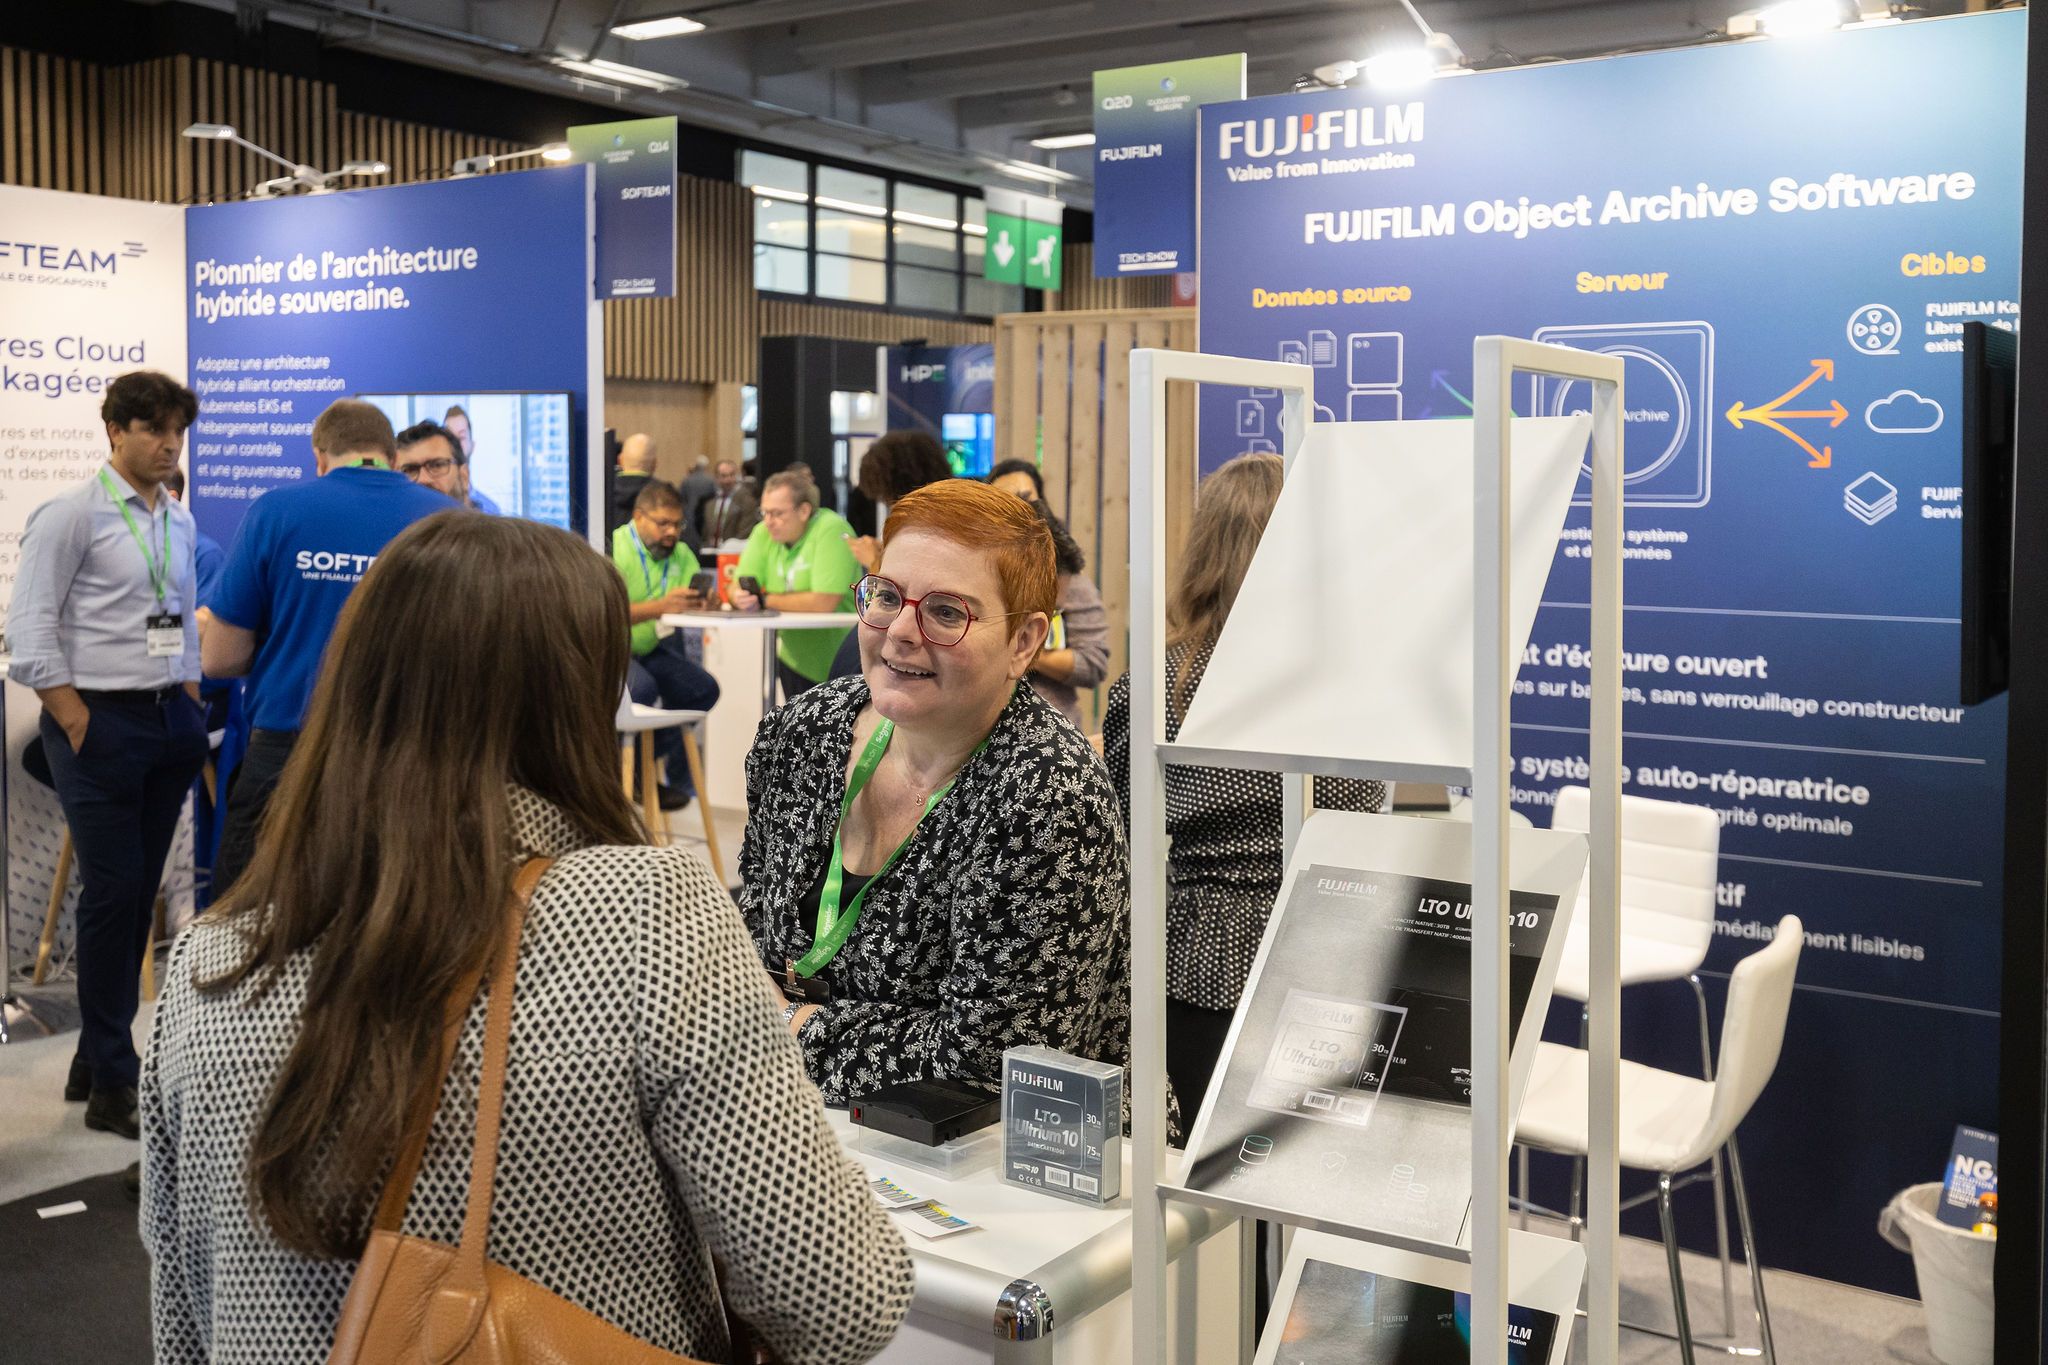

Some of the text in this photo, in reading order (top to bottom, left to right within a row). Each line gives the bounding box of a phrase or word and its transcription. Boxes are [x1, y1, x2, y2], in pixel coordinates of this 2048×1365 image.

[1219, 102, 1425, 160] FUJIFILM
[1100, 144, 1162, 162] FUJIFILM
[1227, 151, 1415, 182] Value from Innovation
[621, 185, 671, 200] SOFTEAM
[1304, 171, 1976, 244] FUJIFILM Object Archive Software
[195, 246, 479, 286] Pionnier de l'architecture
[1901, 250, 1987, 278] Cibles
[1575, 271, 1669, 294] Serveur
[195, 281, 410, 324] hybride souveraine.
[1252, 284, 1412, 309] Données source
[1925, 302, 1995, 317] FUJIFILM
[55, 336, 145, 363] Cloud
[1924, 339, 1965, 354] exist
[196, 354, 330, 373] Adoptez une architecture
[196, 375, 345, 393] hybride alliant orchestration
[257, 399, 280, 414] EKS
[281, 400, 293, 414] et
[30, 427, 46, 440] et
[51, 427, 94, 441] notre
[197, 420, 269, 438] hébergement
[197, 441, 283, 458] pour un contrôle
[19, 467, 48, 480] des
[197, 463, 302, 481] et une gouvernance
[198, 483, 248, 498] renforcée
[1626, 528, 1689, 545] système
[1563, 544, 1581, 559] et
[302, 571, 320, 580] UNE
[321, 572, 351, 582] FILIALE
[1675, 655, 1768, 679] ouvert
[1537, 681, 1568, 697] sur
[1649, 688, 1697, 706] sans
[1701, 692, 1819, 718] verrouillage
[1823, 700, 1965, 723] constructeur
[1521, 756, 1870, 805] systèe auto-réparatrice
[1762, 812, 1853, 836] optimale
[1317, 878, 1378, 896] FUJIFILM
[1417, 897, 1451, 916] LTO
[1851, 933, 1925, 961] lisibles
[1308, 1039, 1340, 1054] LTO
[1012, 1070, 1063, 1092] FUJIFILM
[1035, 1109, 1061, 1125] LTO
